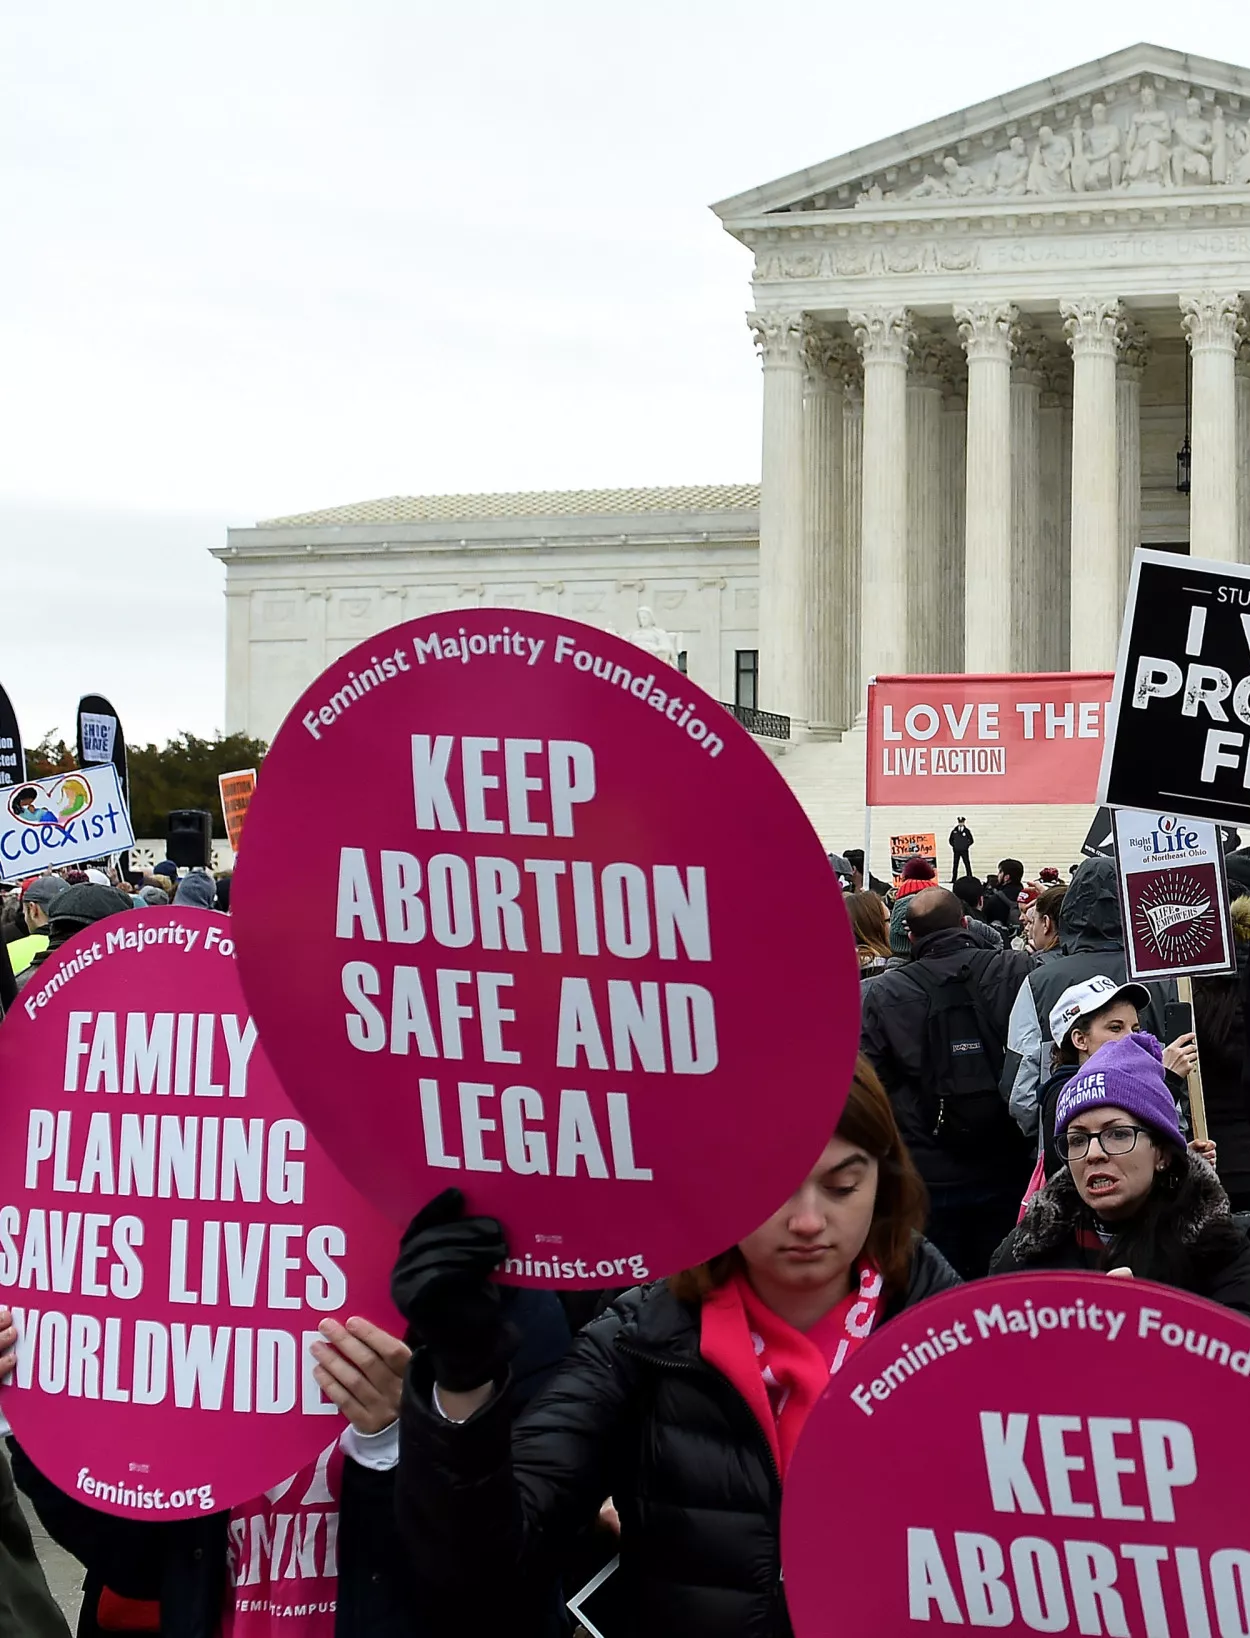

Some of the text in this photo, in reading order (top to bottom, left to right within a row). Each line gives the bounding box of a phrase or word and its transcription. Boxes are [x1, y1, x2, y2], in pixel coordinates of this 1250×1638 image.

[1177, 235, 1249, 253] UNDER
[1185, 605, 1207, 656] I
[302, 627, 725, 758] Feminist Majority Foundation
[883, 701, 1113, 742] LOVE THE
[411, 733, 597, 838] KEEP
[883, 747, 1002, 776] LIVE ACTION
[1129, 836, 1151, 848] Right
[1151, 826, 1199, 854] Life
[1152, 852, 1186, 861] Northeast
[1188, 849, 1207, 857] Ohio
[336, 846, 712, 962] ABORTION
[24, 921, 237, 1020] Feminist Majority Fo
[341, 960, 719, 1075] SAFE AND
[63, 1011, 259, 1098] FAMILY
[24, 1108, 306, 1205] PLANNING
[418, 1078, 654, 1181] LEGAL
[0, 1205, 347, 1312] SAVES LIVES
[850, 1320, 973, 1416] Feminist
[973, 1298, 1126, 1341] Majority
[76, 1467, 215, 1511] feminist.org
[979, 1411, 1198, 1523] KEEP
